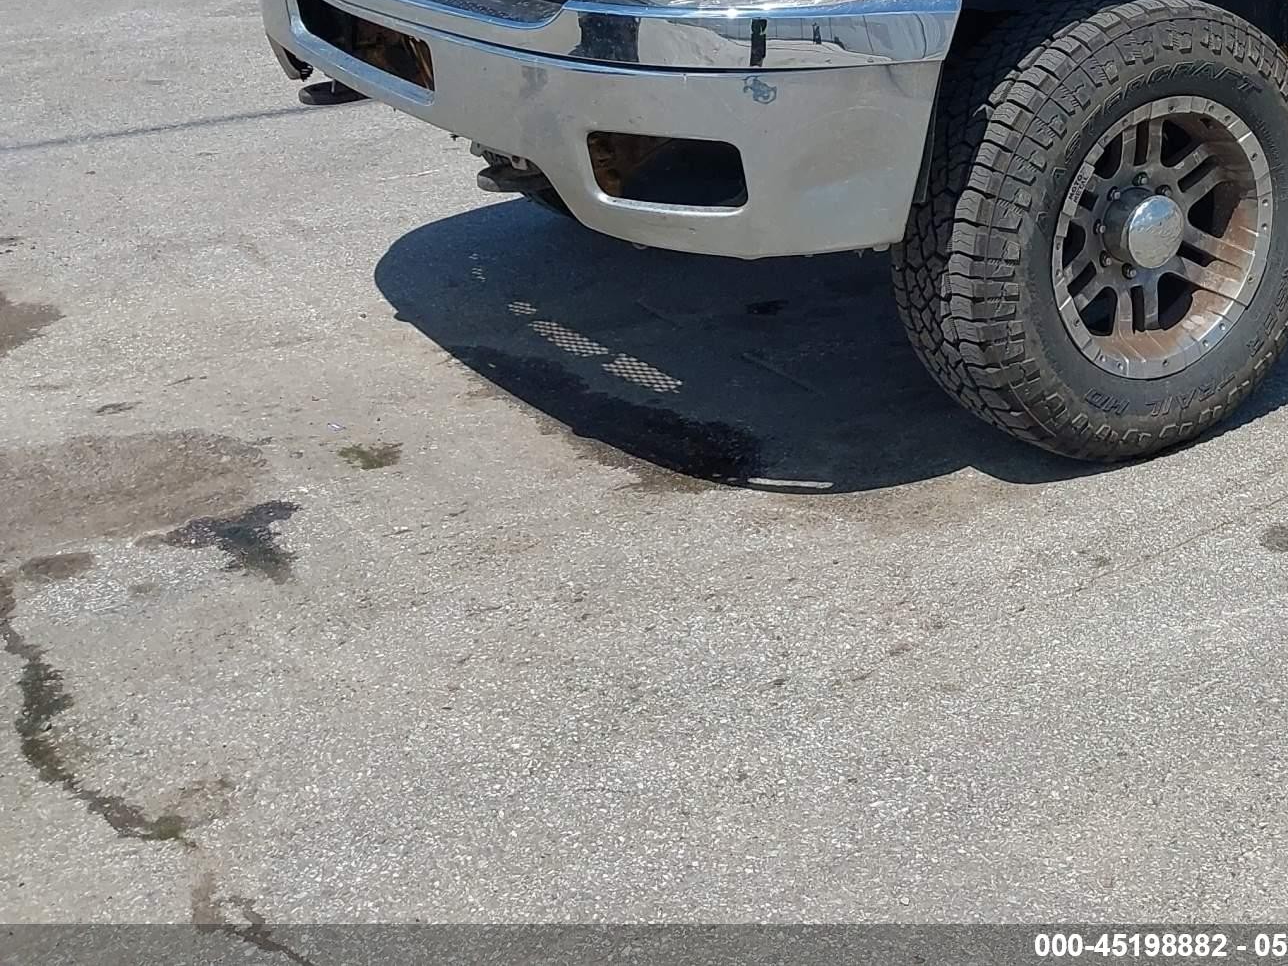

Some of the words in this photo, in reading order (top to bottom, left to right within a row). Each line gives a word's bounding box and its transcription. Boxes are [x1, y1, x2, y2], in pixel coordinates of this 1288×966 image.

[1068, 174, 1083, 200] MOTO
[1073, 176, 1089, 203] METAL
[1085, 388, 1130, 415] HD
